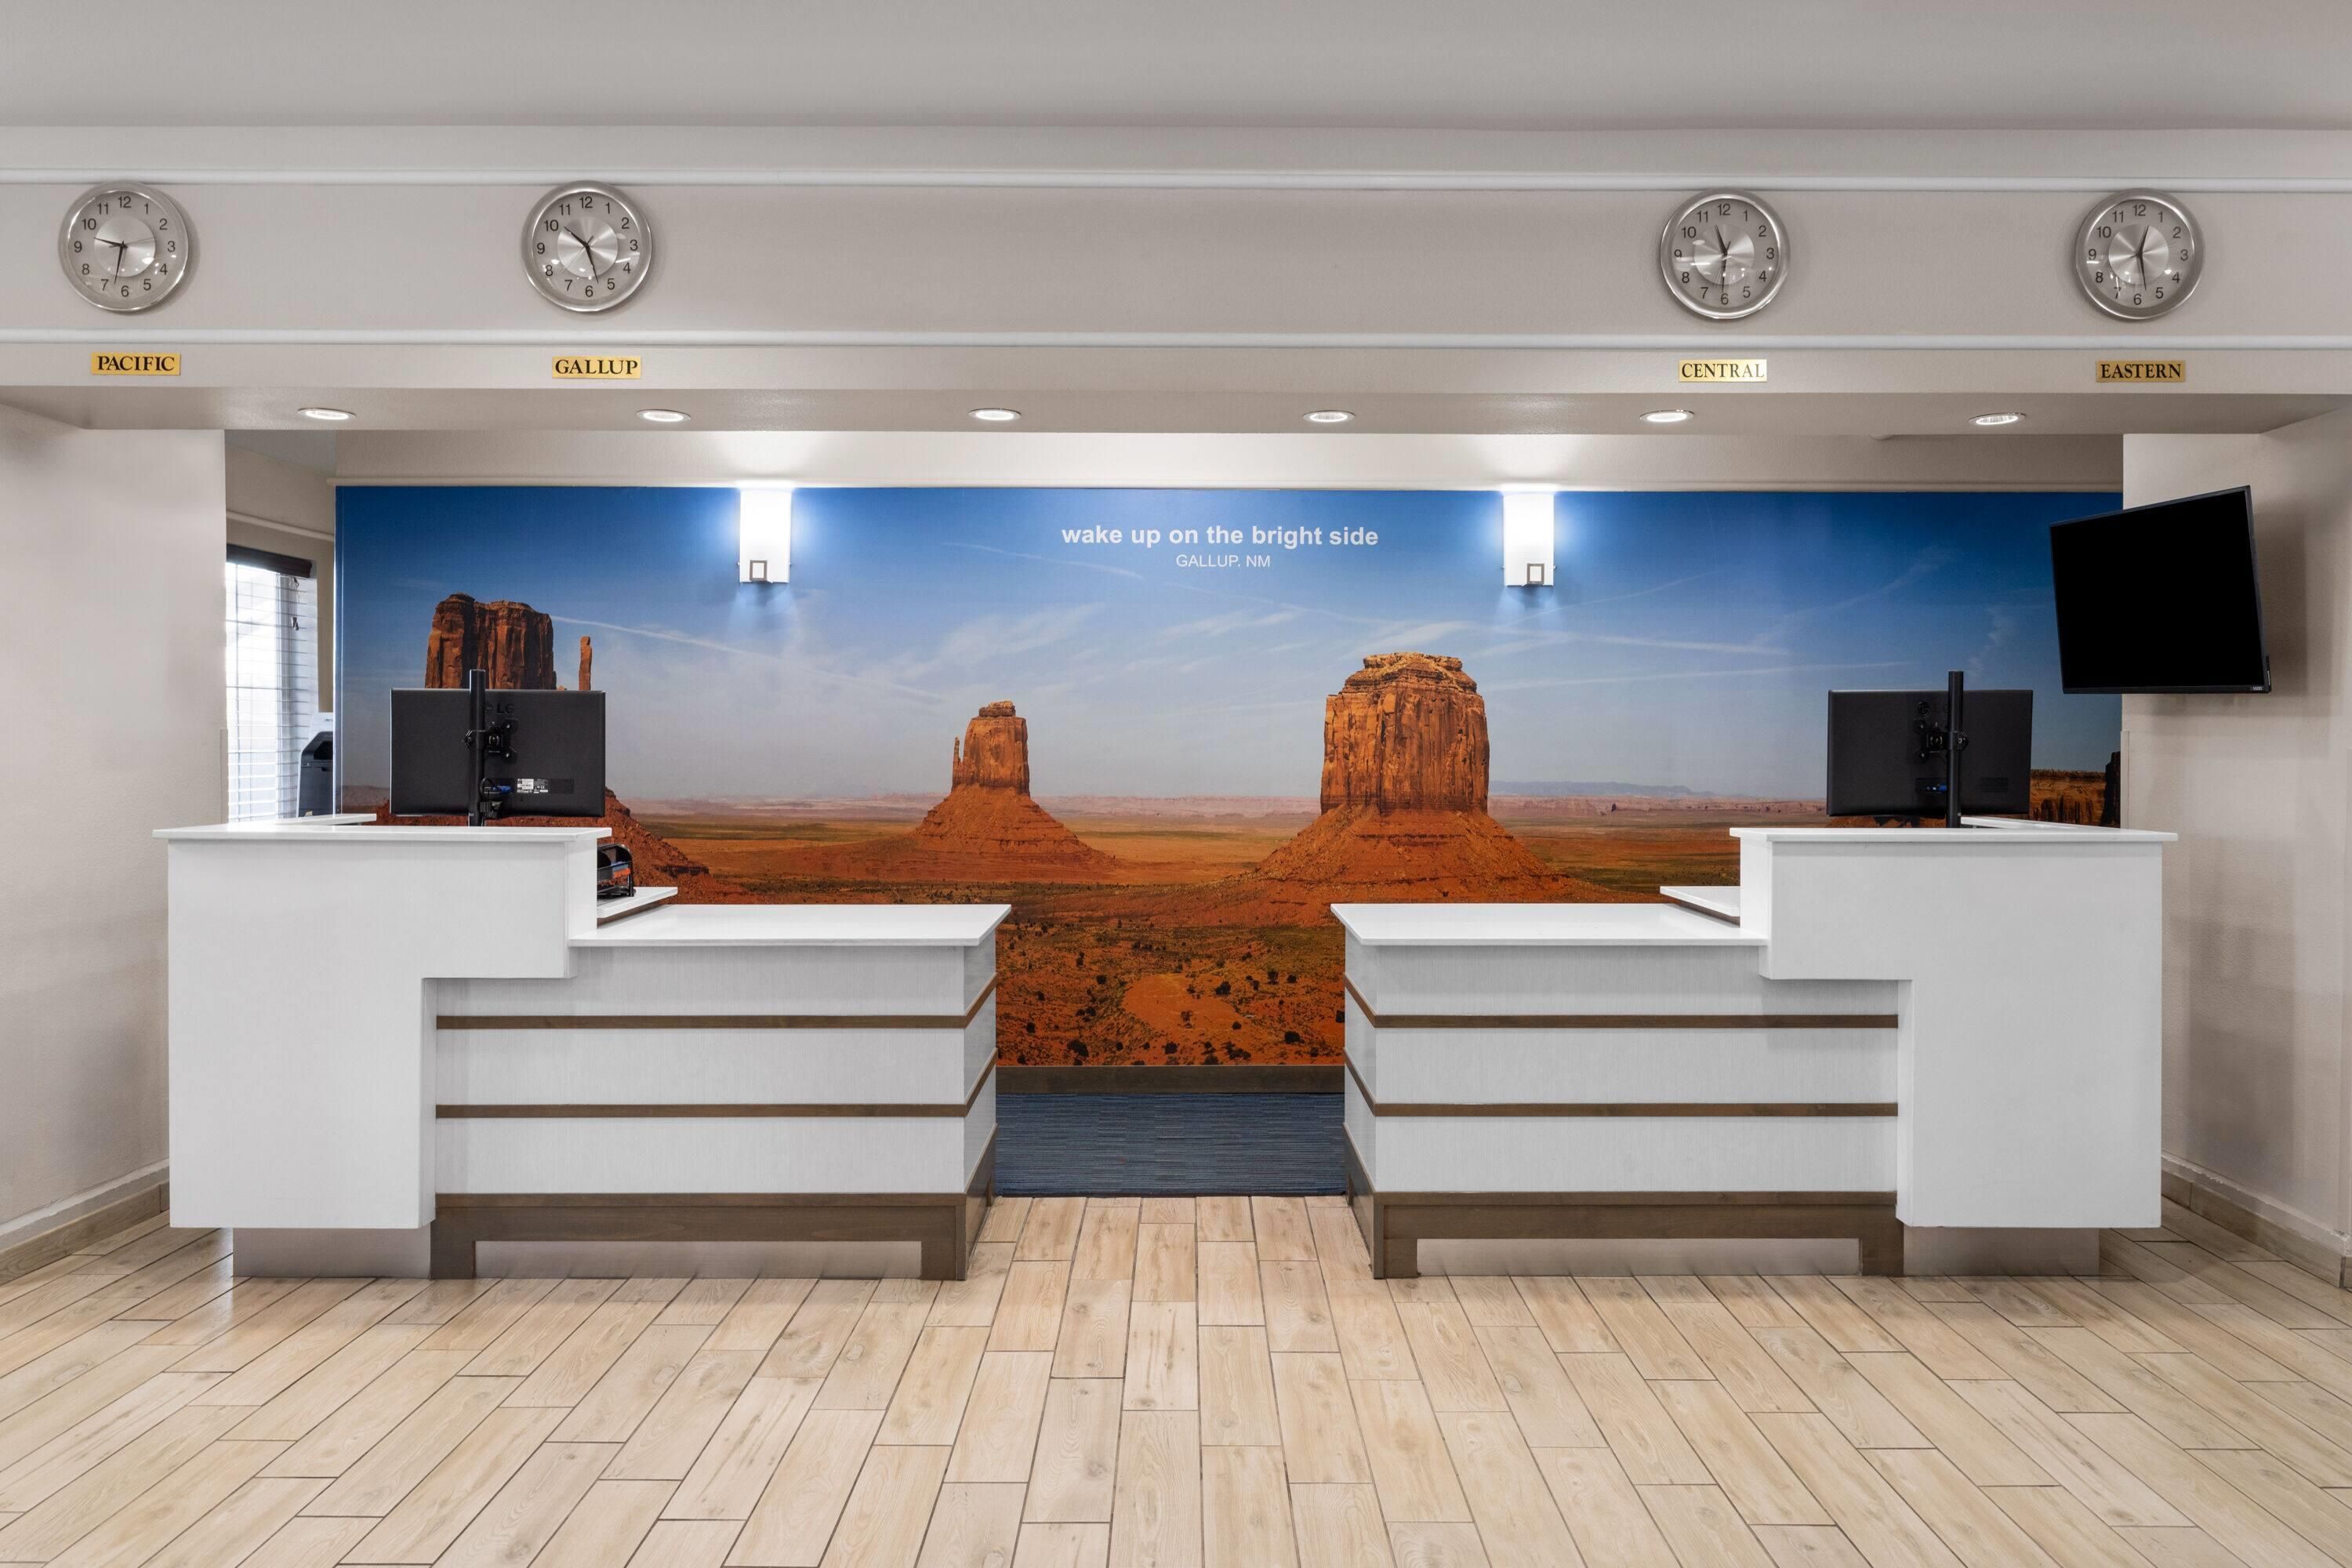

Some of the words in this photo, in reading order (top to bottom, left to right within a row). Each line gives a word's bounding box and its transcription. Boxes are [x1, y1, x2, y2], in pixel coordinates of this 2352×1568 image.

[118, 196, 131, 208] 12
[579, 197, 593, 209] 12
[605, 202, 610, 213] 1
[97, 203, 108, 215] 11
[144, 203, 148, 214] 1
[559, 204, 570, 216] 11
[1718, 204, 1730, 216] 12
[2132, 205, 2146, 216] 12
[1697, 211, 1708, 223] 11
[1744, 211, 1748, 221] 1
[2112, 211, 2124, 223] 11
[2158, 212, 2163, 223] 1
[82, 219, 96, 230] 10
[159, 219, 167, 230] 2
[544, 220, 558, 231] 10
[621, 217, 630, 229] 2
[1682, 227, 1696, 238] 10
[1759, 226, 1766, 237] 2
[2096, 227, 2111, 238] 10
[2173, 227, 2181, 238] 2
[74, 241, 82, 252] 9
[167, 241, 176, 252] 3
[537, 242, 545, 254] 9
[630, 239, 638, 251] 3
[1675, 249, 1682, 258] 9
[1766, 248, 1774, 260] 3
[2089, 249, 2096, 260] 9
[2180, 249, 2188, 260] 3
[82, 263, 89, 275] 8
[160, 263, 168, 275] 4
[545, 265, 553, 276] 8
[623, 263, 630, 274] 4
[1682, 272, 1690, 283] 8
[1759, 270, 1766, 281] 4
[2096, 272, 2103, 283] 8
[2172, 272, 2180, 283] 4
[101, 279, 109, 291] 7
[143, 279, 151, 290] 5
[564, 280, 572, 291] 7
[608, 278, 615, 290] 5
[121, 285, 129, 297] 6
[585, 285, 593, 297] 6
[1700, 287, 1708, 299] 7
[1743, 286, 1751, 298] 5
[2156, 287, 2163, 299] 5
[1721, 293, 1729, 305] 6
[2133, 293, 2141, 305] 6
[97, 355, 175, 371] PACIFIC
[555, 359, 637, 375] GALLUP
[1682, 363, 1764, 378] CENTRAL
[2101, 364, 2181, 378] EASTERN
[1062, 525, 1123, 544] wake
[1131, 528, 1160, 548] up
[1169, 528, 1198, 544] on
[1207, 525, 1243, 544] the
[1253, 526, 1323, 549] bright
[1329, 526, 1378, 546] side
[1246, 555, 1271, 568] NM
